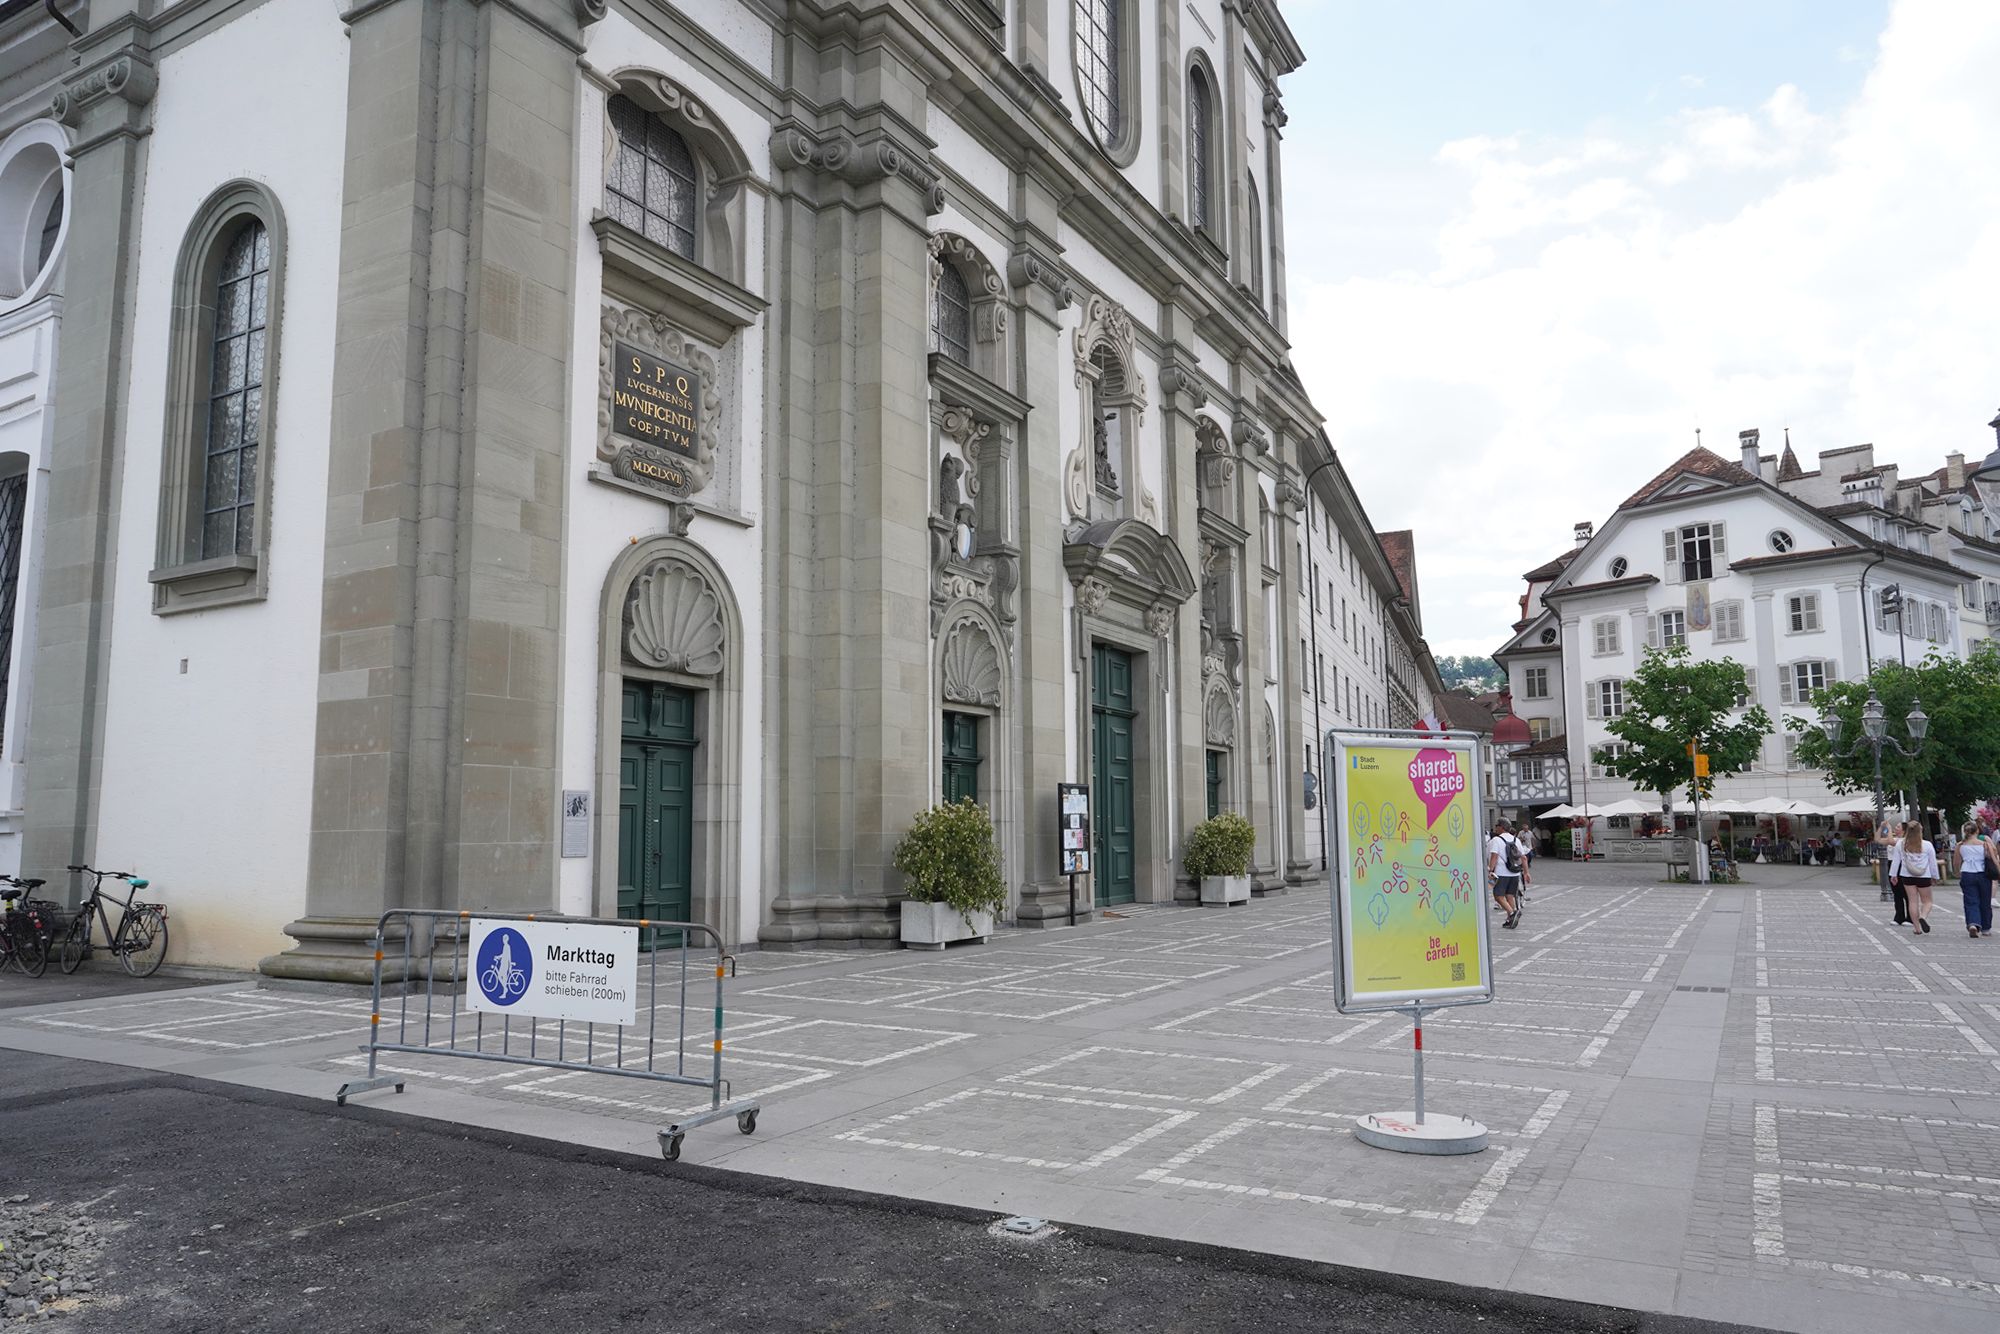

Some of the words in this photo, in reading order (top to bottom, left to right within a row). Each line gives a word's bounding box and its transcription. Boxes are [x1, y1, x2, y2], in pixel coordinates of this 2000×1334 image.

[627, 377, 693, 412] LVCERNENSIS
[629, 416, 690, 448] COEPTVM
[1409, 754, 1456, 779] shared
[1424, 774, 1463, 798] space
[1426, 942, 1459, 961] careful
[1429, 936, 1441, 949] be
[547, 945, 615, 969] Markttag
[546, 970, 567, 982] bitte
[569, 972, 607, 986] Fahrrad
[545, 985, 588, 998] schieben
[591, 988, 626, 1003] (200m)
